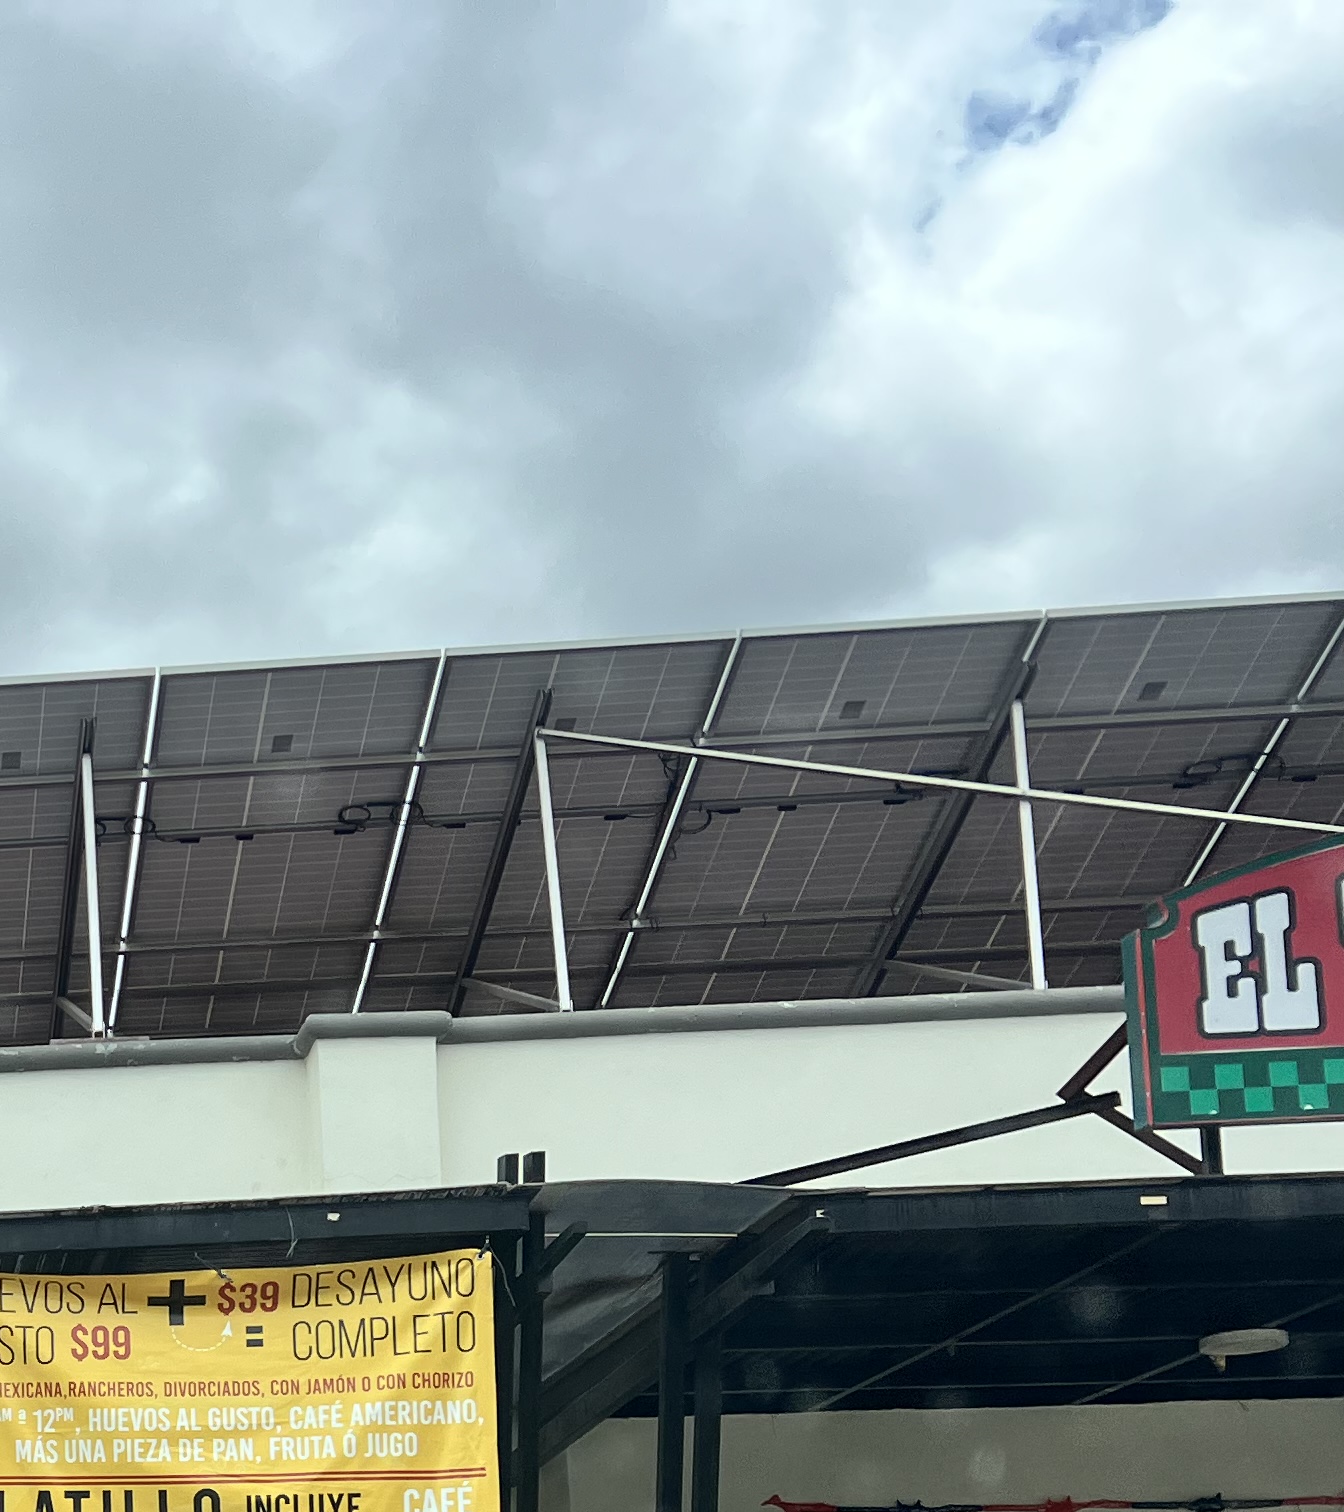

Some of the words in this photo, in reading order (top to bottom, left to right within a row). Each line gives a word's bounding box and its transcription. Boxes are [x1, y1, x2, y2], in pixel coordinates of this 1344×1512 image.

[1192, 890, 1322, 1036] EL
[97, 1283, 138, 1315] AL
[217, 1281, 279, 1316] $39
[292, 1258, 474, 1309] DESAYUNO
[71, 1324, 131, 1362] $99
[292, 1310, 476, 1361] COMPLETO
[164, 1380, 265, 1398] DIVORCIADOS,
[270, 1379, 300, 1396] CON
[305, 1374, 356, 1396] JAMÓN
[362, 1376, 371, 1392] O
[377, 1373, 406, 1391] CON
[412, 1371, 474, 1390] CHORIZO
[89, 1407, 171, 1433] HUEVOS
[176, 1407, 202, 1432] AL
[208, 1406, 282, 1434] GUSTO,
[289, 1401, 343, 1430] CAFÉ
[350, 1398, 484, 1427] AMERICANO,
[15, 1436, 58, 1464] MÁS
[65, 1439, 106, 1463] UNA
[113, 1438, 172, 1463] PIEZA
[178, 1438, 205, 1462] DE
[212, 1438, 261, 1464] PAN,
[269, 1435, 336, 1461] FRUTA
[343, 1429, 357, 1458] Ó
[364, 1432, 418, 1458] JUGO
